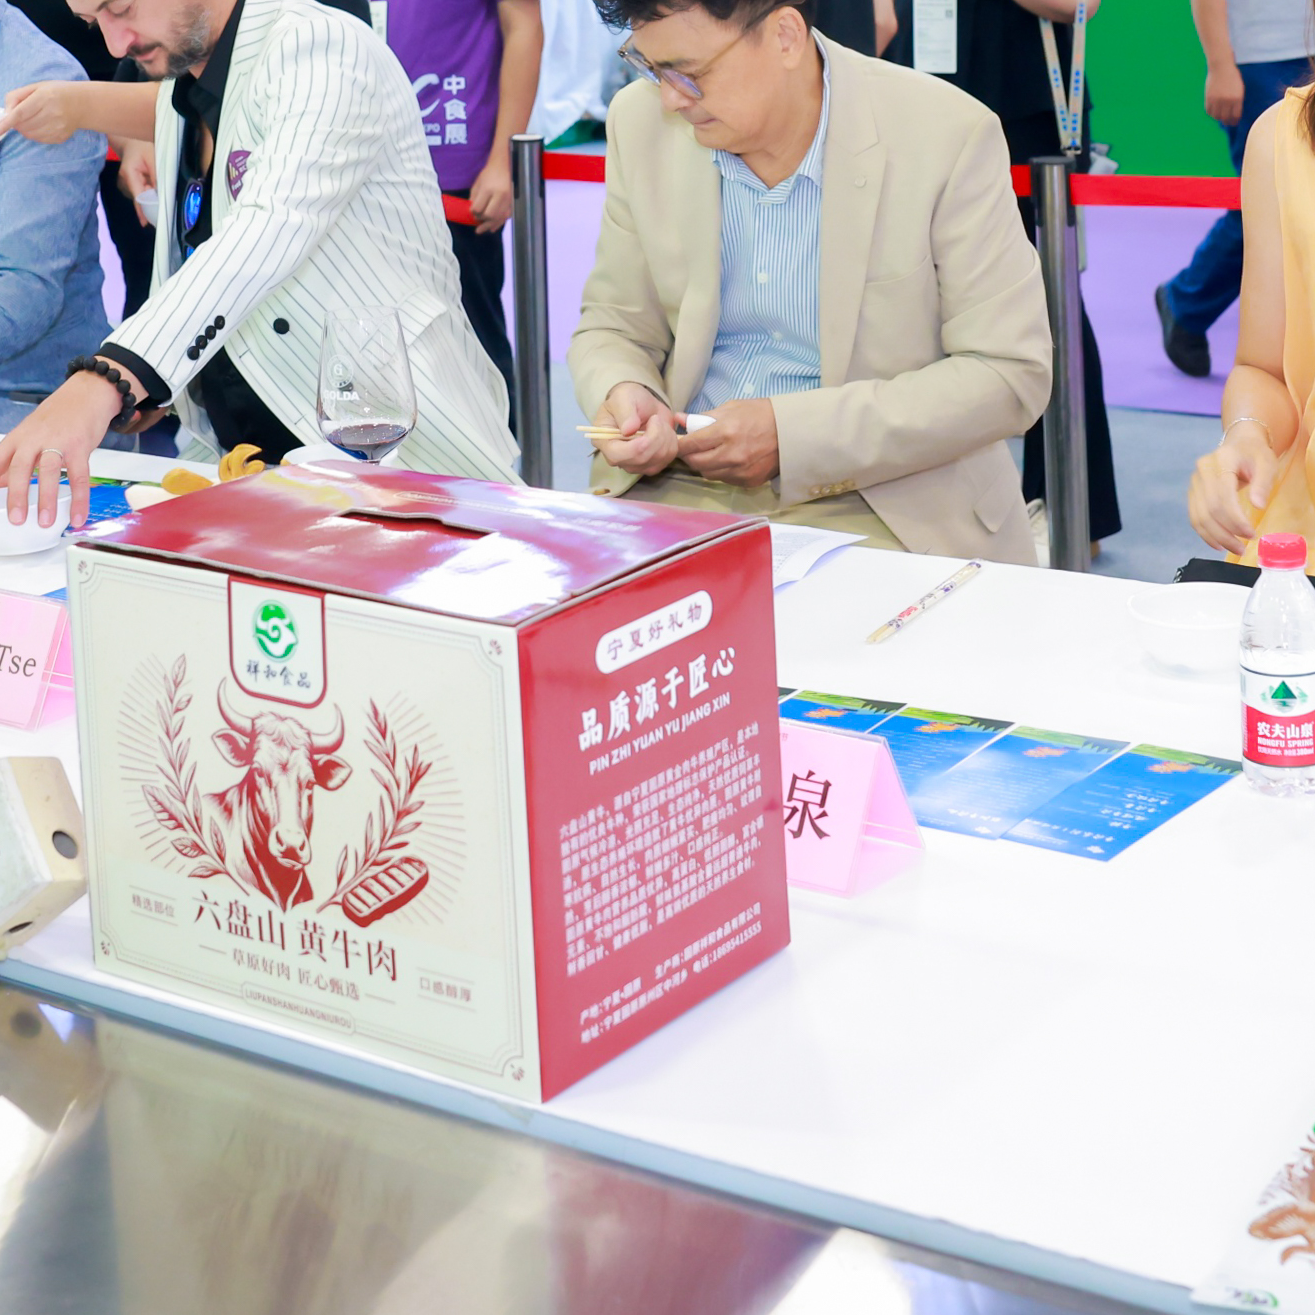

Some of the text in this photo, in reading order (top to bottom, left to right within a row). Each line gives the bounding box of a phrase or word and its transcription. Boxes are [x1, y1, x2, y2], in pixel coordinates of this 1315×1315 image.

[443, 74, 468, 145] 中食展
[607, 602, 702, 660] 宁夏好礼物
[578, 647, 735, 752] 品质源于匠心
[589, 692, 731, 776] PIN ZHI YUAN YU JIANG XIN
[1257, 721, 1314, 739] 农夫山泉
[1257, 736, 1314, 748] NONGFU SPRING
[191, 890, 397, 983] 六盘山 黄牛肉
